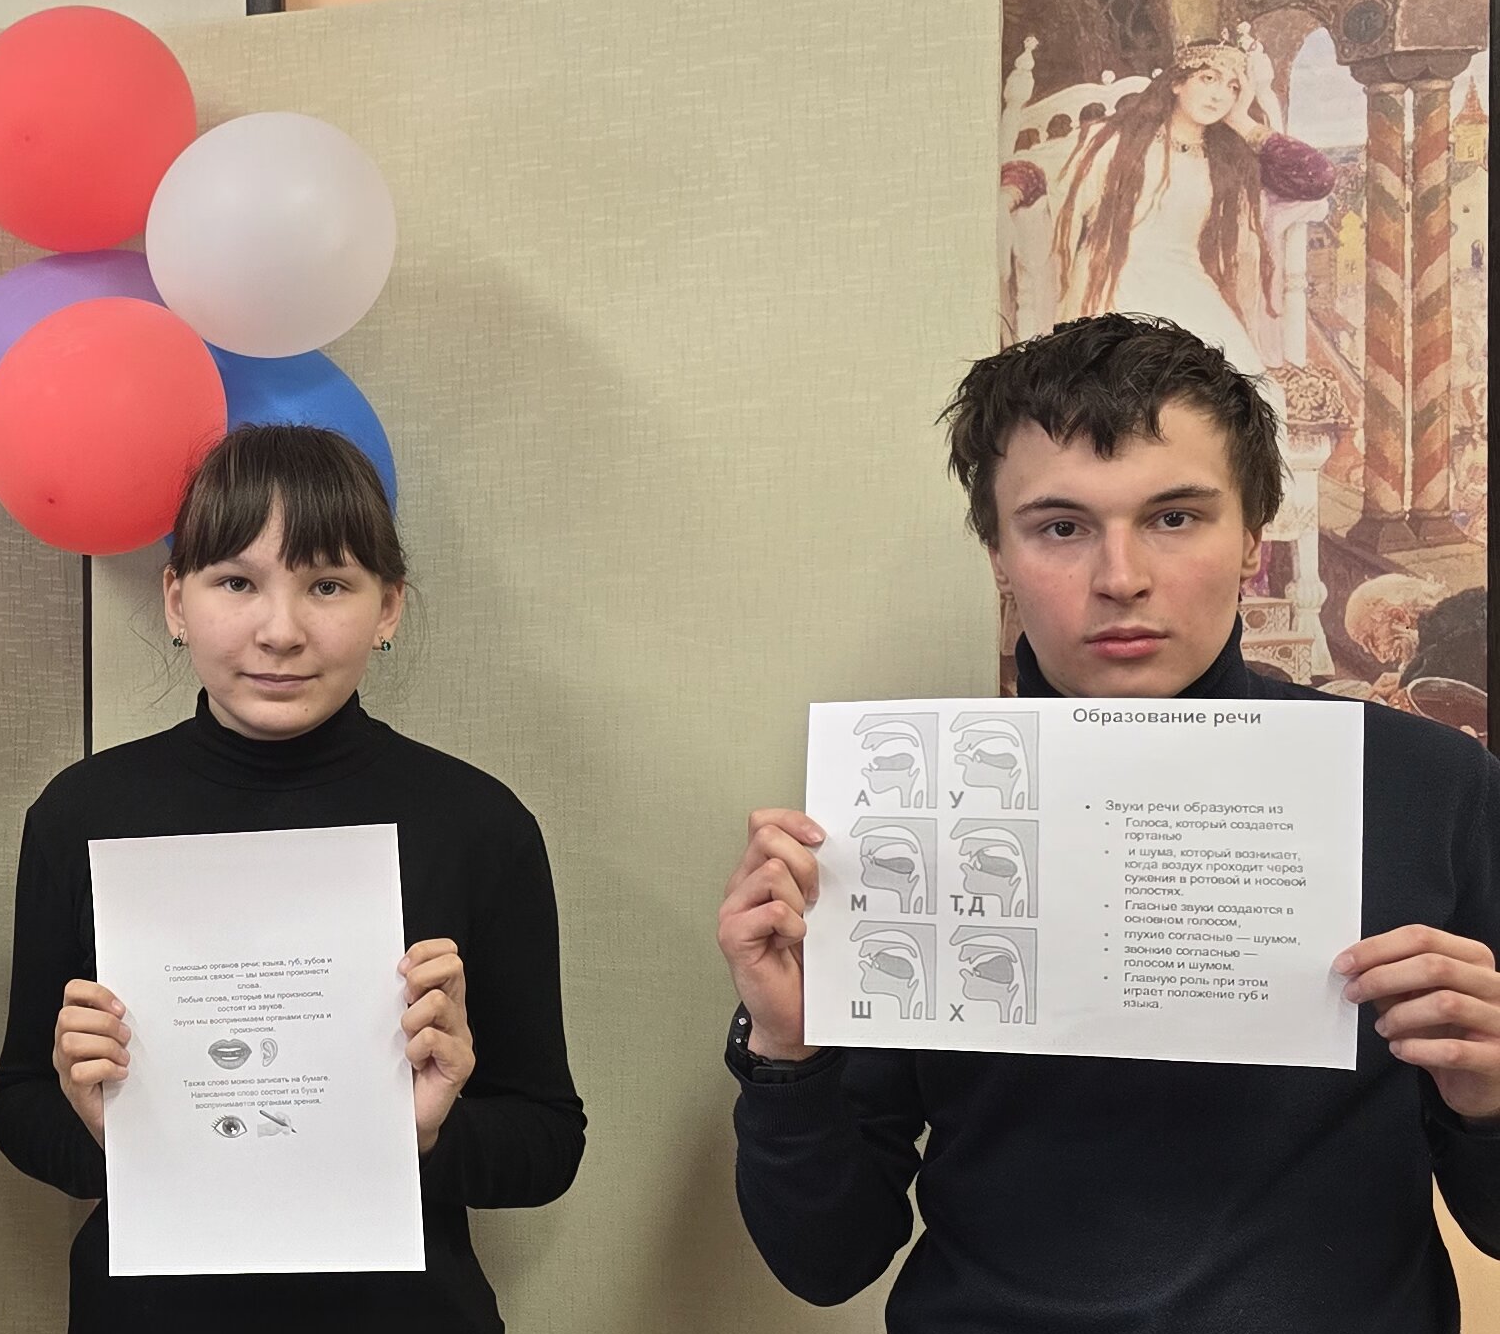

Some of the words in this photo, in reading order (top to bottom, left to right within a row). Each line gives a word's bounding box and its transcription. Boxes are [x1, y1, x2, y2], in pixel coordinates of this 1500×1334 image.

[1072, 708, 1207, 726] Образование
[1213, 712, 1261, 727] речи
[854, 790, 870, 807] А
[950, 791, 965, 808] У
[1105, 799, 1144, 813] Звуки
[1148, 803, 1180, 814] речи
[1183, 802, 1265, 816] образуются
[1268, 805, 1284, 814] из
[1125, 817, 1172, 829] Голоса,
[1175, 819, 1227, 831] который
[1124, 832, 1182, 842] гортанью
[1139, 848, 1177, 859] шума,
[1180, 848, 1231, 860] который
[1234, 850, 1301, 861] возникает,
[1124, 861, 1158, 870] когда
[1161, 862, 1203, 872] воздух
[1206, 862, 1263, 873] проходит
[1266, 864, 1304, 875] через
[1124, 874, 1176, 885] сужения
[1190, 875, 1240, 886] ротовой
[1255, 877, 1307, 887] носовой
[1124, 887, 1184, 896] полостях.
[850, 894, 867, 912] М
[1125, 900, 1177, 911] Гласные
[1180, 904, 1214, 914] звуки
[1217, 905, 1283, 915] создаются
[1124, 915, 1183, 925] основном
[1124, 931, 1165, 941] глухие
[1168, 932, 1233, 942] согласные
[1253, 935, 1301, 946] шумом,
[1124, 946, 1172, 955] звонкие
[1176, 948, 1241, 958] согласные
[1124, 959, 1175, 969] голосом
[1188, 962, 1235, 972] шумом.
[1124, 972, 1177, 985] Главную
[1180, 976, 1210, 986] роль
[1213, 978, 1235, 988] при
[1238, 978, 1268, 987] этом
[1123, 987, 1164, 998] играет
[1167, 989, 1235, 999] положение
[1238, 991, 1259, 1002] губ
[851, 1001, 872, 1019] Ш
[1123, 1000, 1163, 1009] языка.
[950, 1004, 965, 1022] Х
